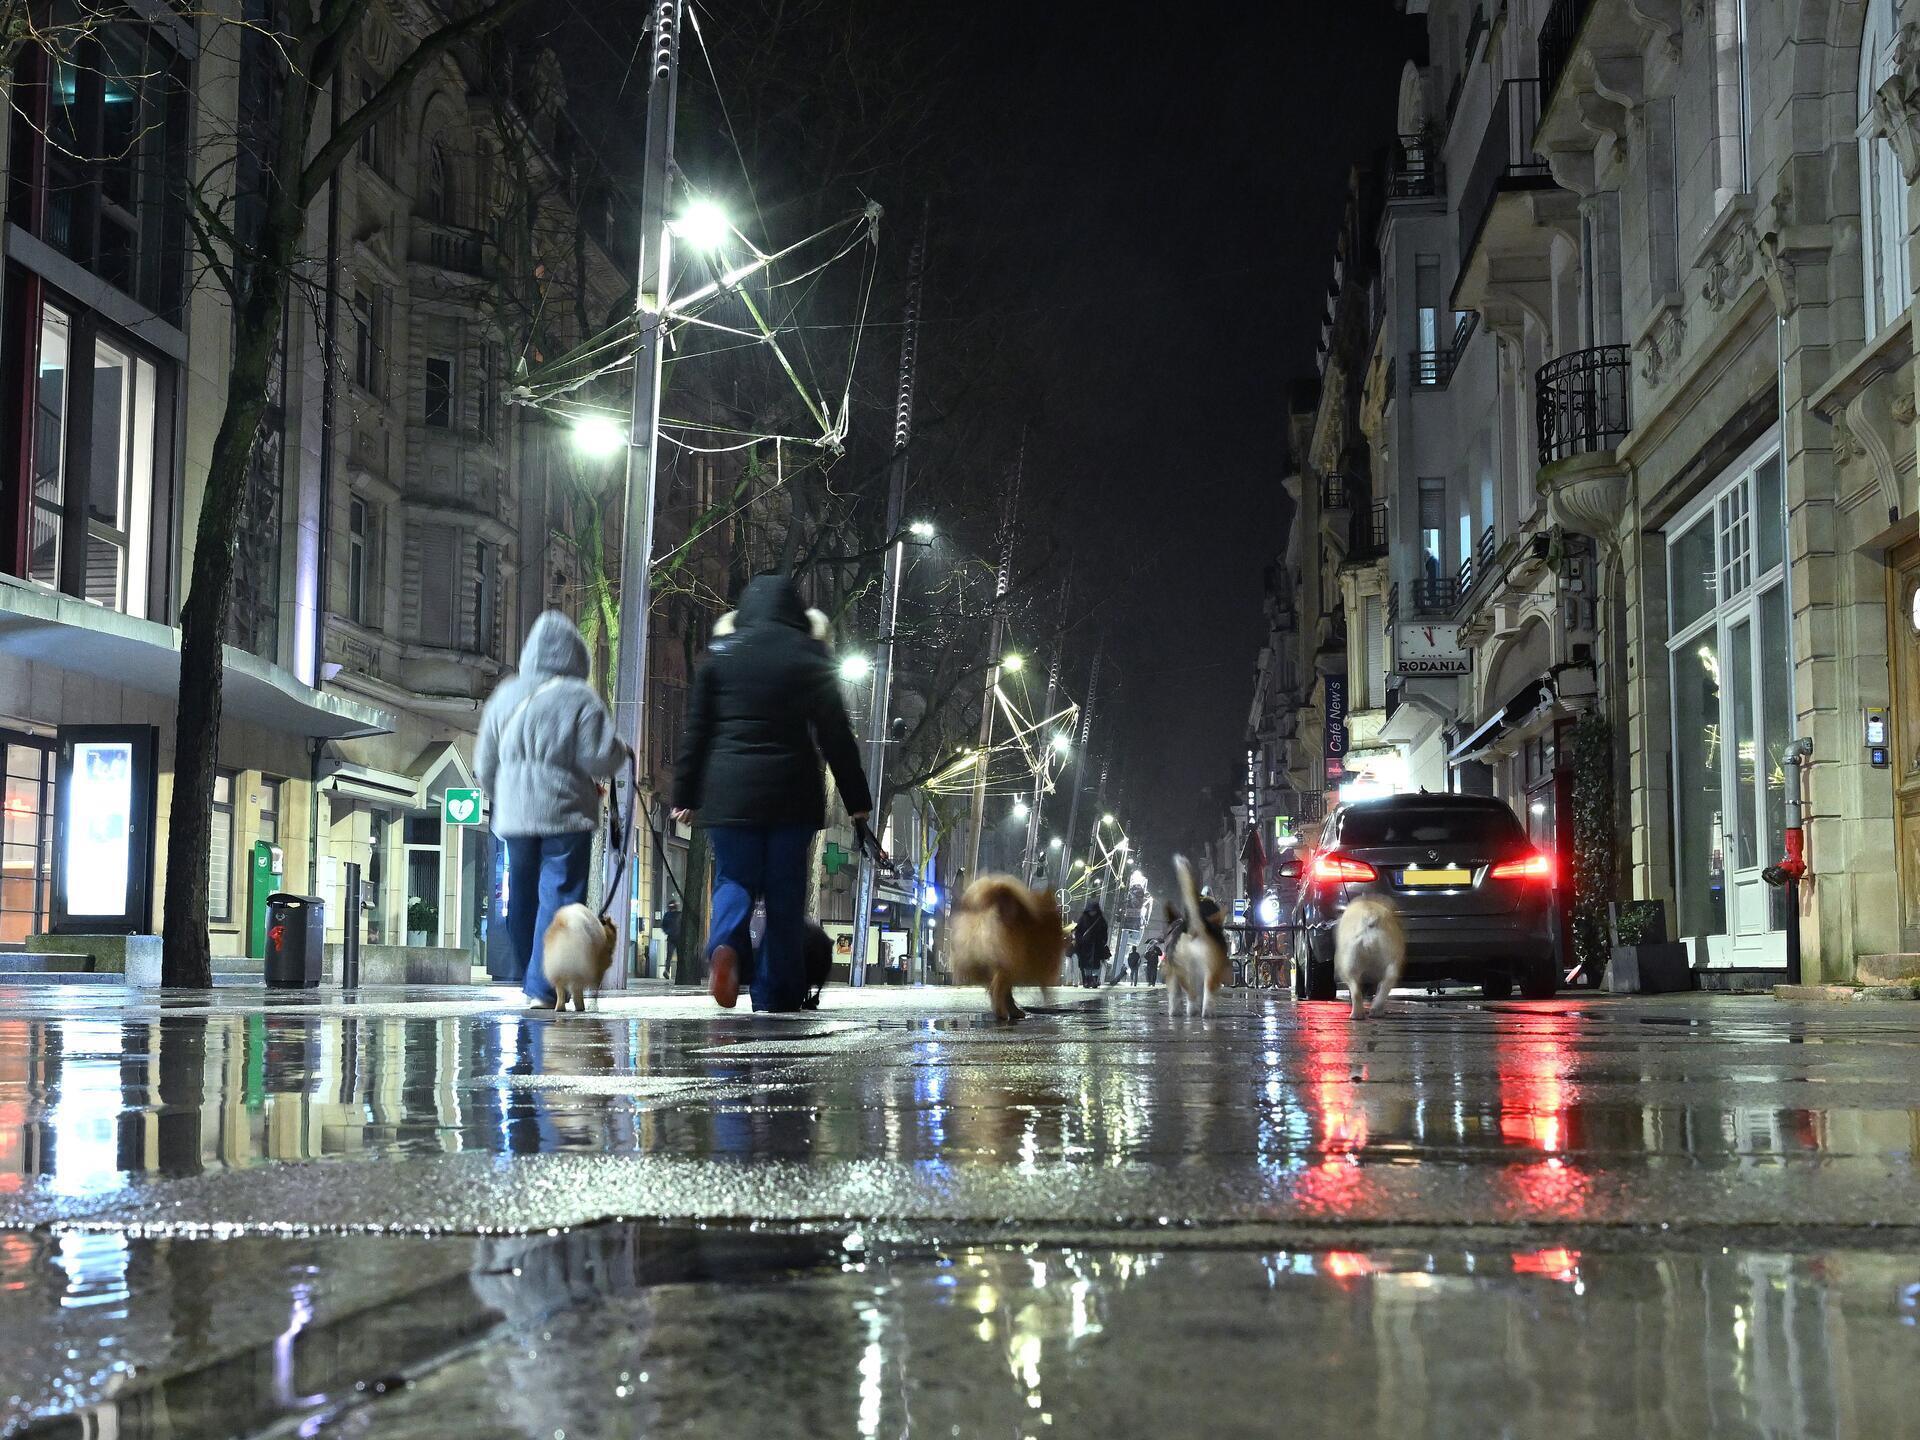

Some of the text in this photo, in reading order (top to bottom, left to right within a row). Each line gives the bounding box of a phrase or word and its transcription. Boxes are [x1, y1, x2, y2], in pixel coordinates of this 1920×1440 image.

[1398, 661, 1467, 672] RODANIA
[1329, 682, 1341, 720] New's
[1329, 722, 1341, 752] Café
